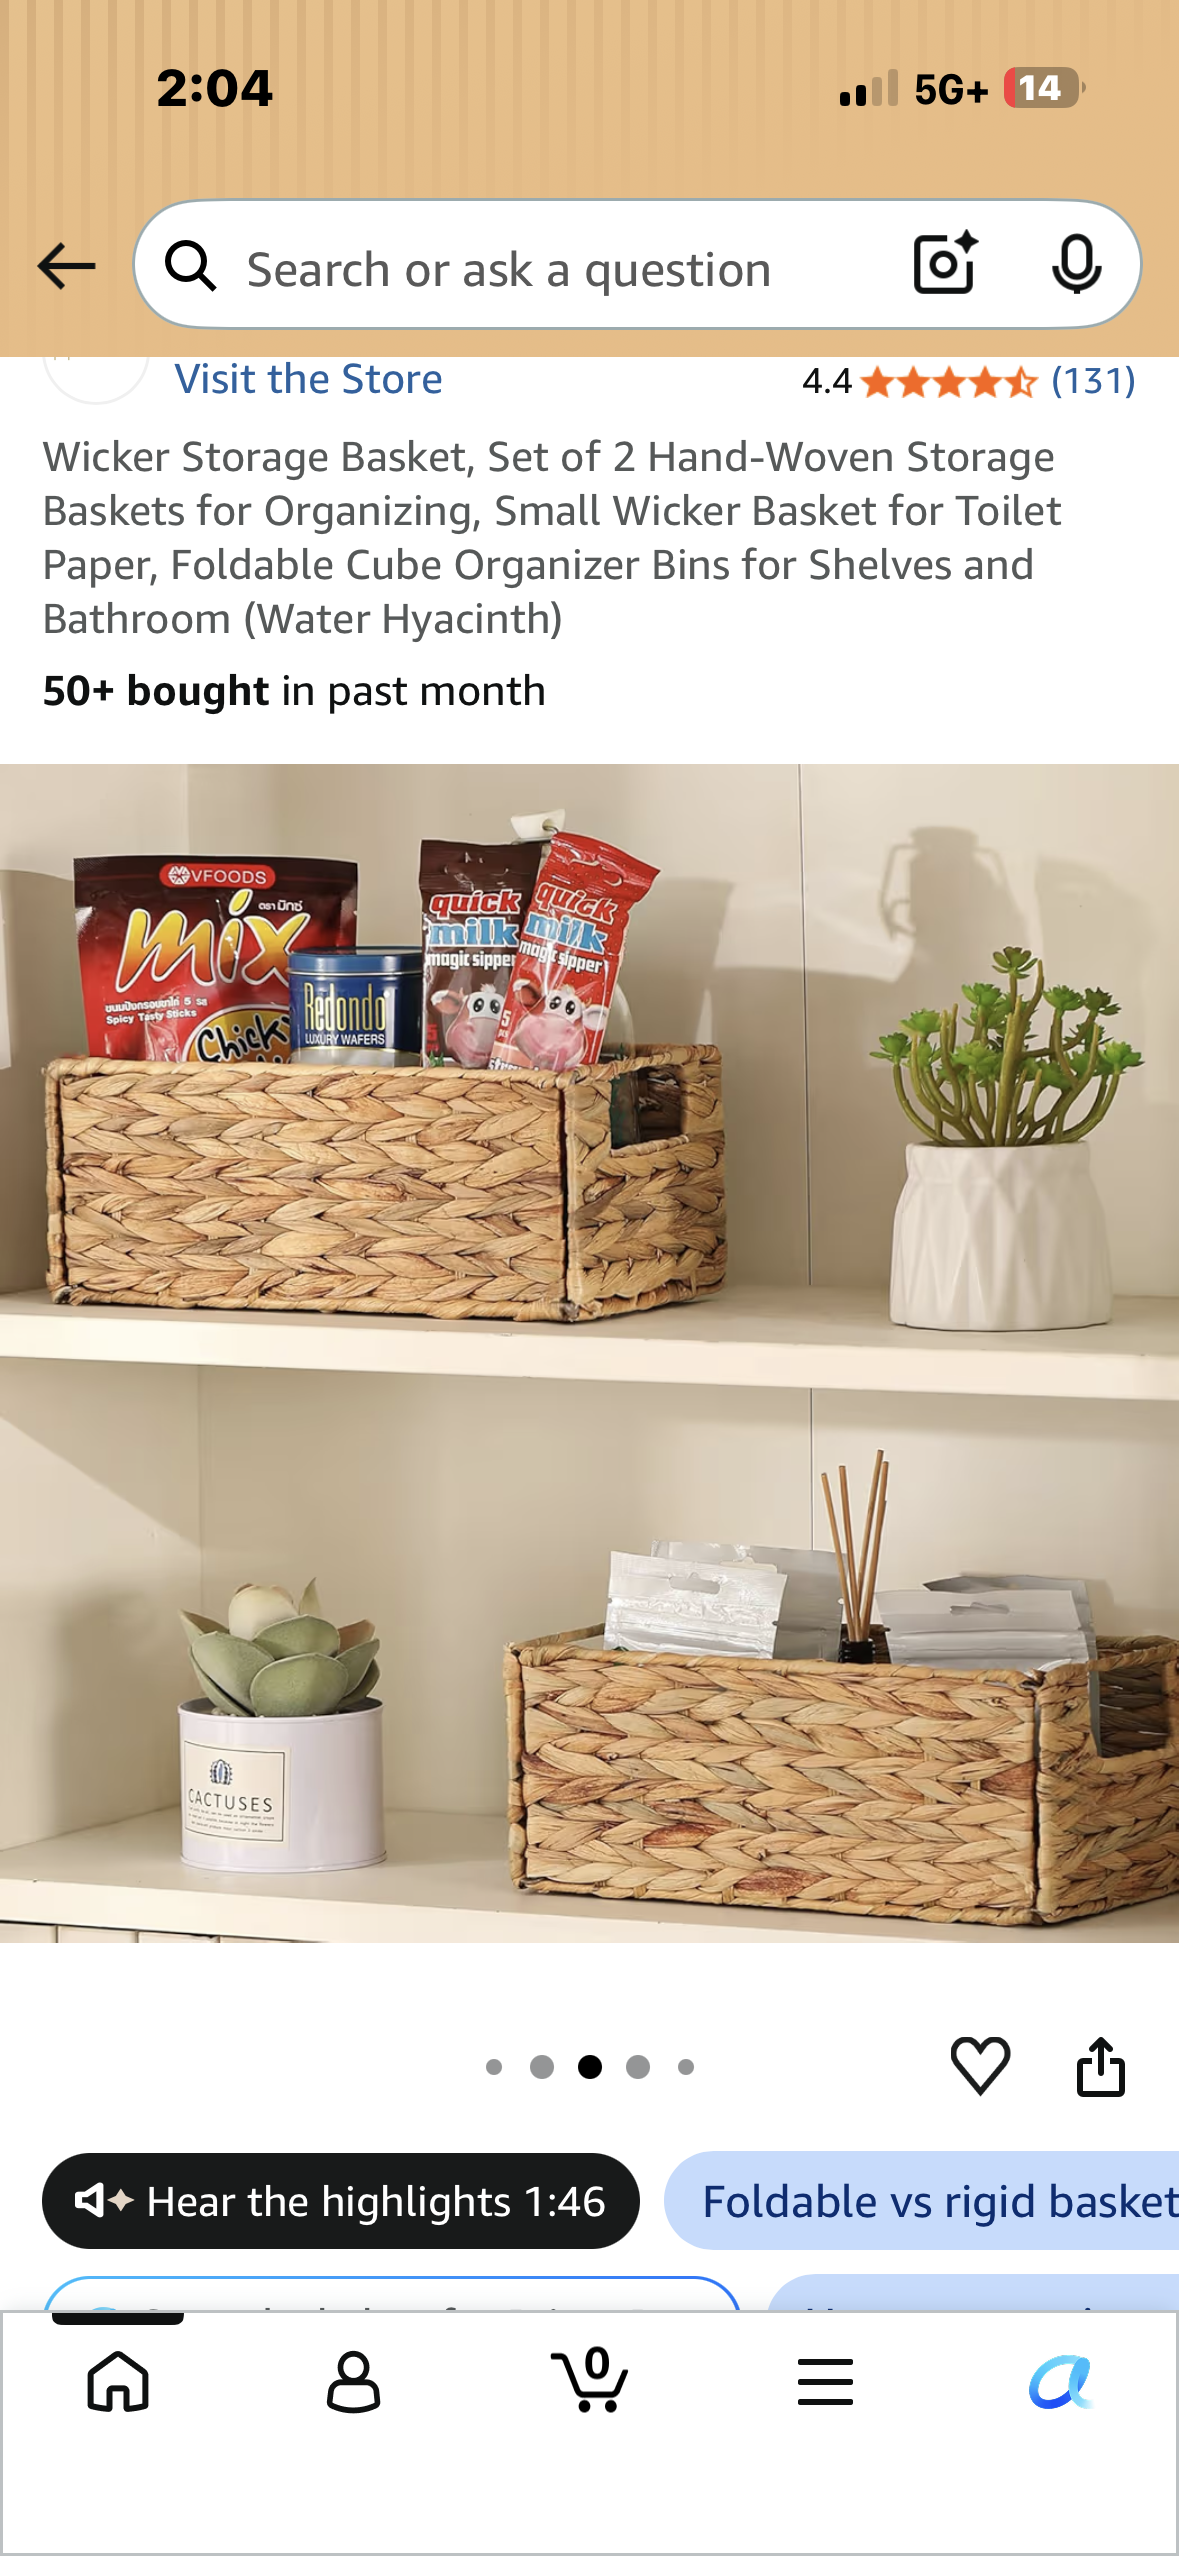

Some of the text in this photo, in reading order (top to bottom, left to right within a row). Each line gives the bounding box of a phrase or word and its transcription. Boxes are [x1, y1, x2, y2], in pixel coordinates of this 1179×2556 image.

[158, 69, 273, 107] 2:04
[916, 74, 988, 105] 5G+
[1020, 75, 1061, 100] 14
[249, 250, 769, 296] Search or ask a question
[174, 362, 441, 394] Visit the Store
[803, 368, 852, 394] 4.4
[1053, 366, 1134, 398] (131)
[43, 439, 1053, 480] Wicker Storage Basket, Set of 2 Hand-Woven Storage
[45, 493, 1061, 534] Baskets for Organizing, Small Wicker Basket for Toilet
[45, 547, 1032, 588] Paper, Foldable Cube Organizer Bins for Shelves and
[45, 601, 561, 642] Bathroom (Water Hyacinth)
[44, 674, 544, 714] 50+ bought in past month
[191, 869, 267, 885] VFOODS
[430, 889, 521, 920] quick
[536, 882, 618, 925] quick
[115, 888, 311, 993] mix
[429, 917, 520, 948] milk
[524, 912, 608, 954] milk
[426, 950, 469, 970] magic
[557, 950, 603, 974] sipper
[106, 1009, 197, 1025] Spicy Tasty Sticks
[304, 982, 386, 1031] Redondo
[501, 1009, 512, 1027] 5
[305, 1034, 385, 1045] LUXURY WAFERS
[188, 1788, 273, 1813] CACTUSES
[149, 2185, 605, 2225] Hear the highlights 1:46
[706, 2184, 1179, 2227] Foldable vs rigid basket
[585, 2346, 609, 2380] 0
